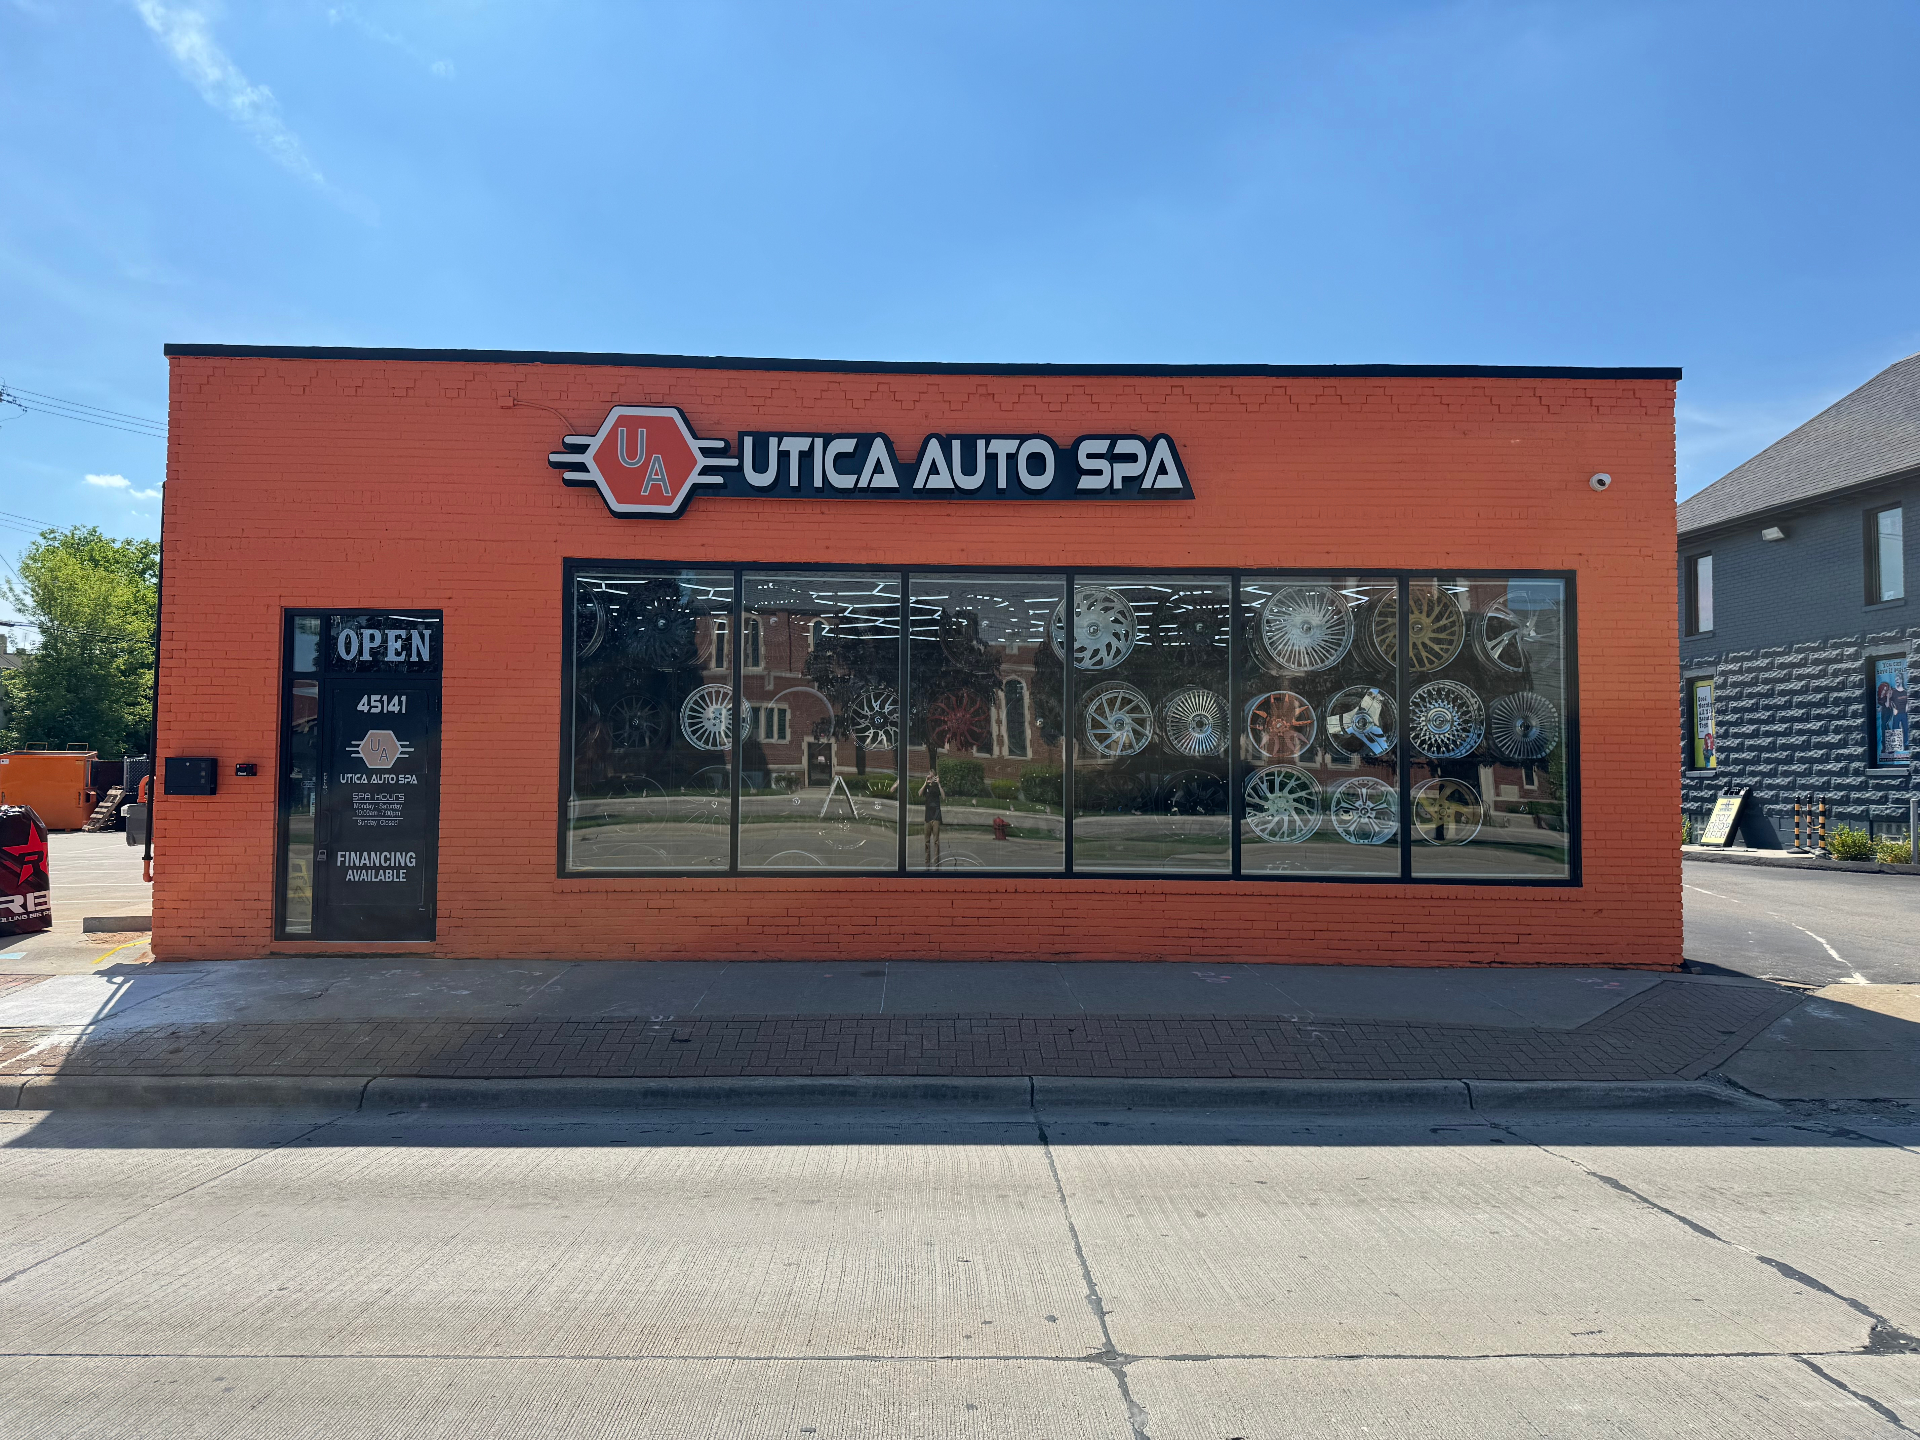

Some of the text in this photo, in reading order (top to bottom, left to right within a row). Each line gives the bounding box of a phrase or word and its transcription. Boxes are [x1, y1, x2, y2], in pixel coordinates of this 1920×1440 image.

[743, 436, 1184, 490] UTICA AUTO SPA
[336, 628, 433, 662] OPEN
[356, 694, 407, 714] 45141
[340, 773, 368, 785] UTICA
[370, 773, 396, 785] AUTO
[398, 774, 418, 785] SPA
[336, 851, 417, 867] FINANCING
[345, 869, 407, 882] AVAILABLE
